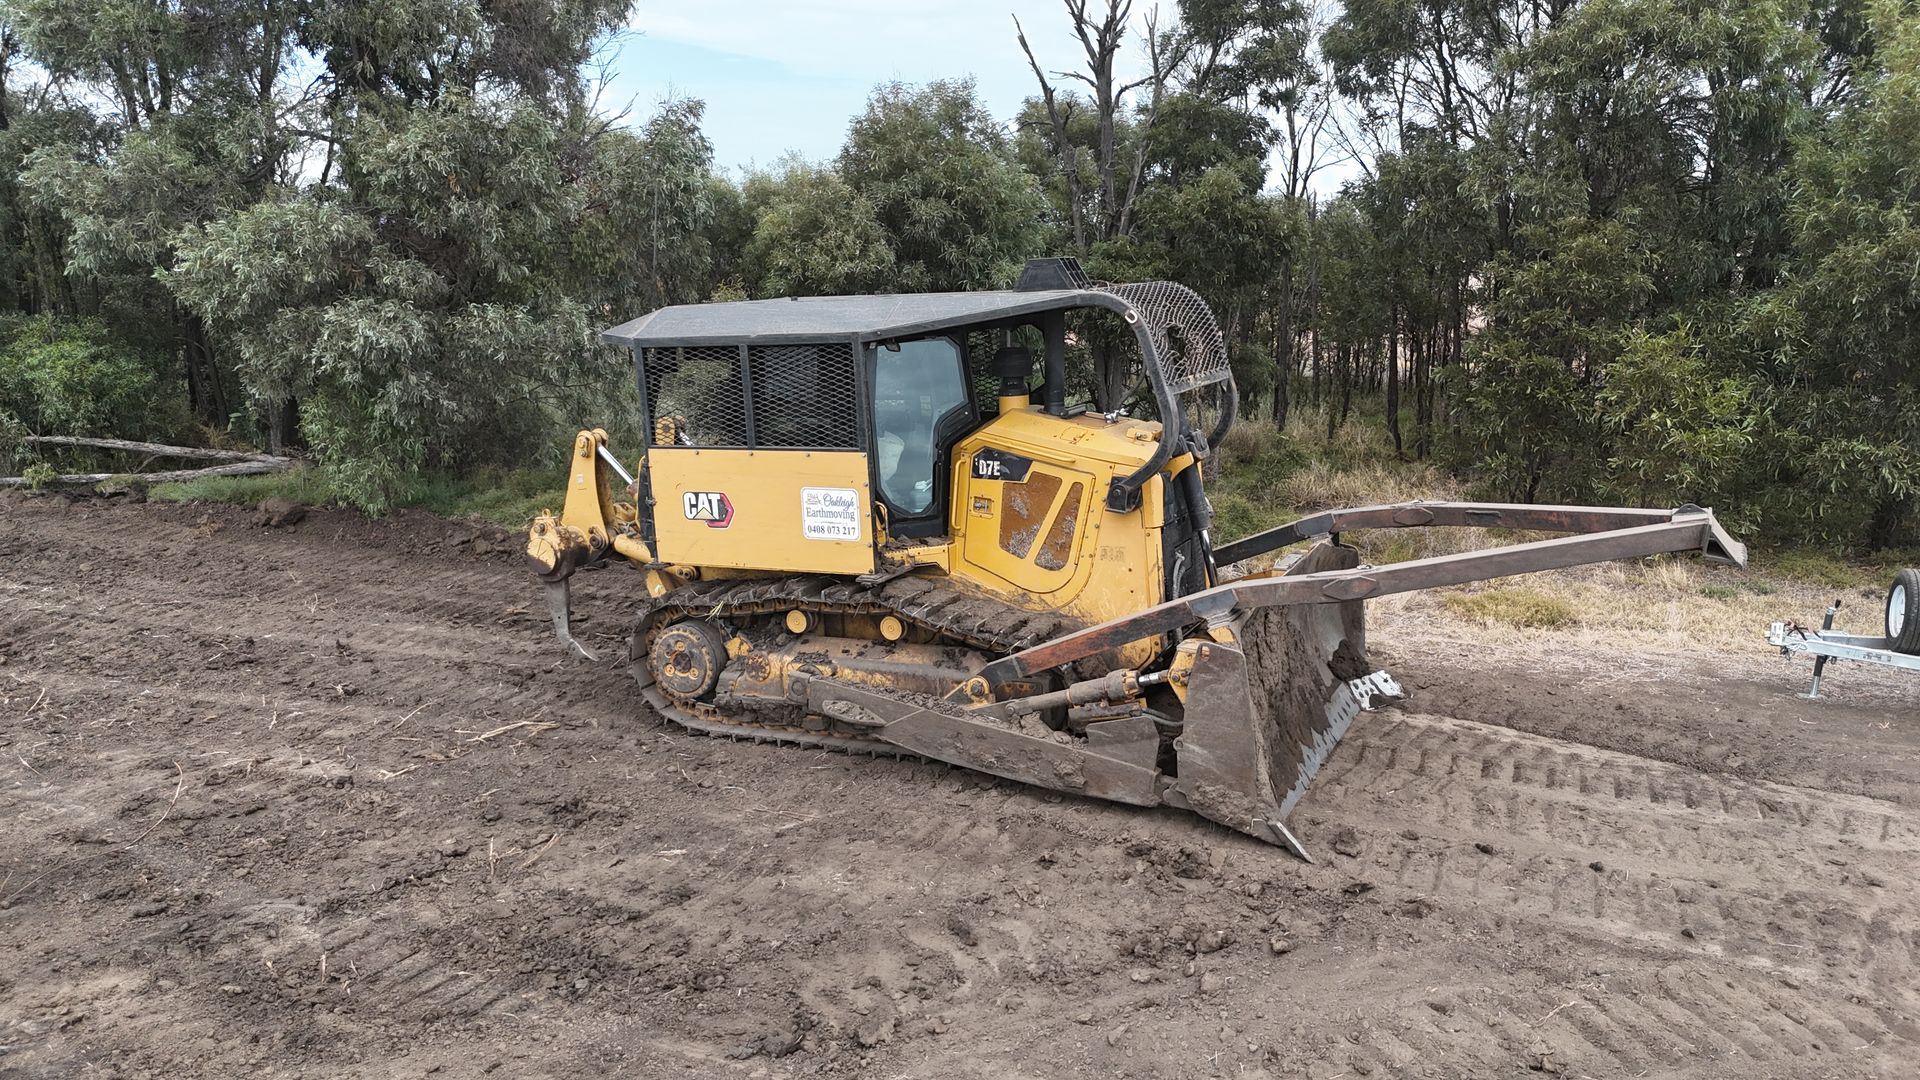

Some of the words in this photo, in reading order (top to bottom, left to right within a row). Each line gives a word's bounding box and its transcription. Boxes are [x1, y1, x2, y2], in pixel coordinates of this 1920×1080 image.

[979, 460, 1000, 475] D7E
[684, 493, 720, 519] CAT
[806, 507, 855, 522] Earthmoving
[808, 525, 825, 534] 0408
[827, 526, 840, 535] 073
[842, 526, 855, 536] 217
